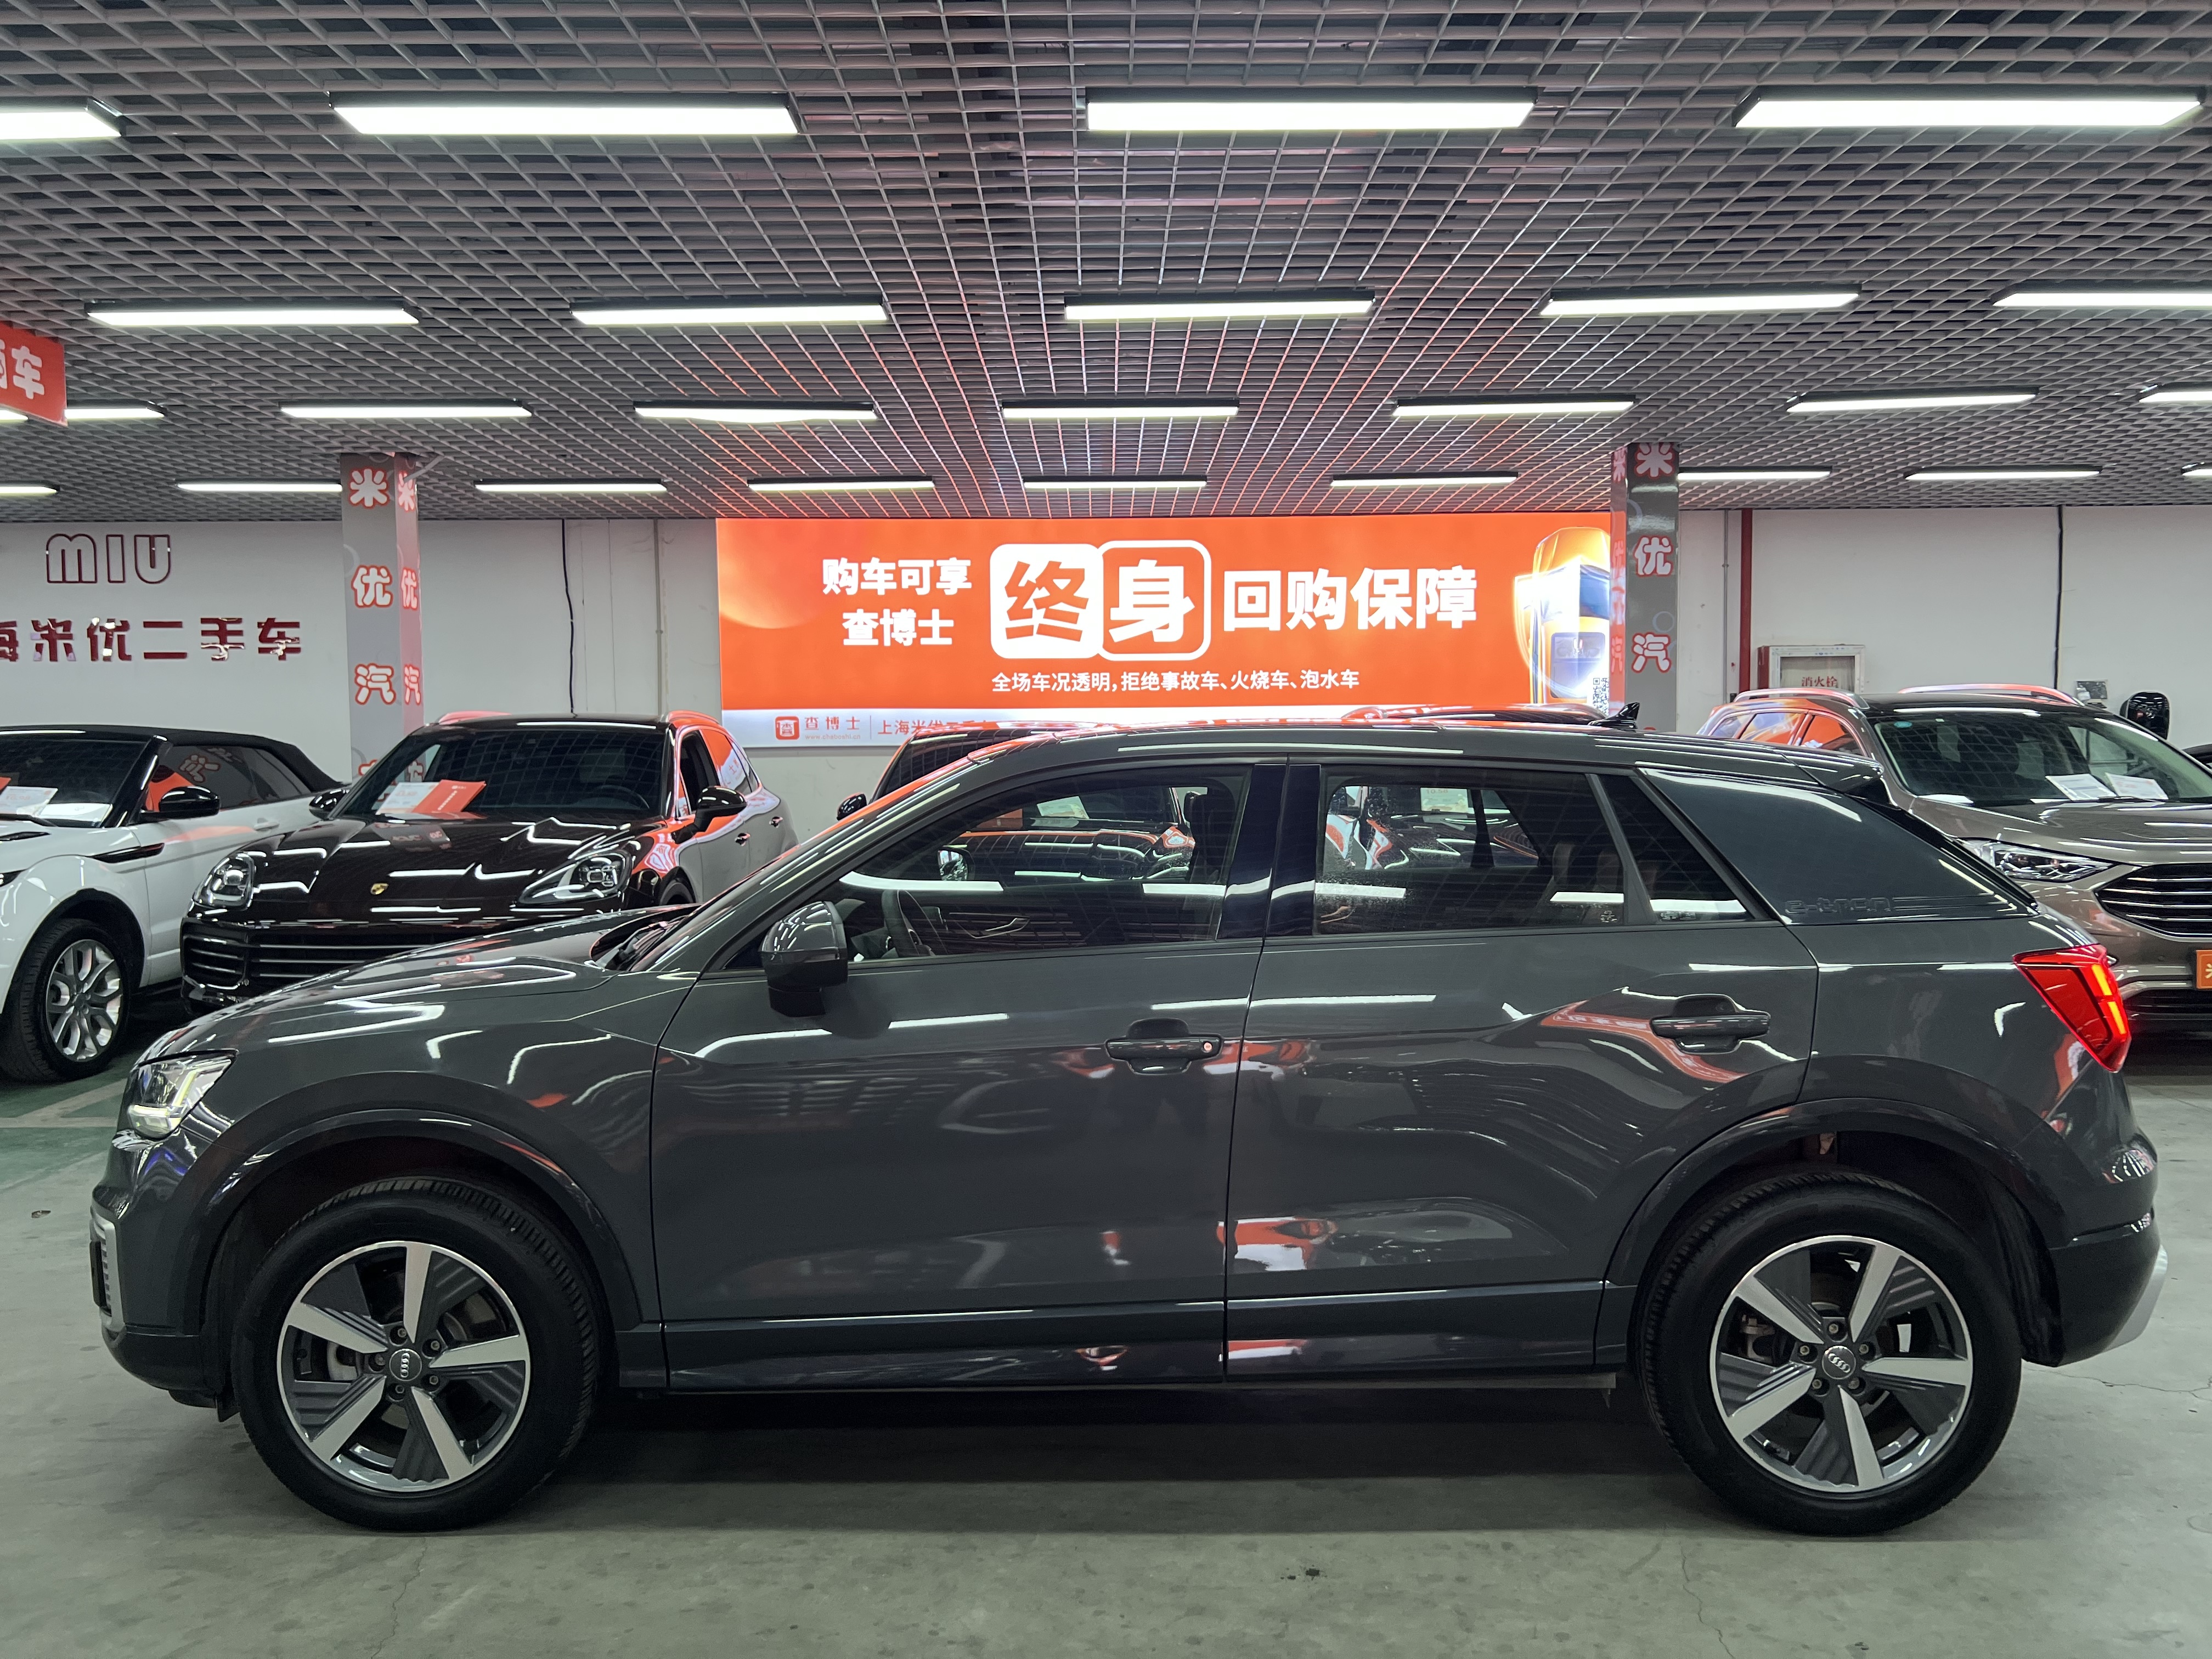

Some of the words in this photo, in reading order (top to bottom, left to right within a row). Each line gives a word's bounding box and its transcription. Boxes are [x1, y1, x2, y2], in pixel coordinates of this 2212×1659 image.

[822, 557, 972, 595] 购车可享
[1005, 559, 1195, 642] 终身
[1223, 566, 1477, 632] 回购保障
[842, 608, 954, 646] 查博士
[1802, 676, 1838, 688] 消火栓
[805, 716, 860, 730] 查博士
